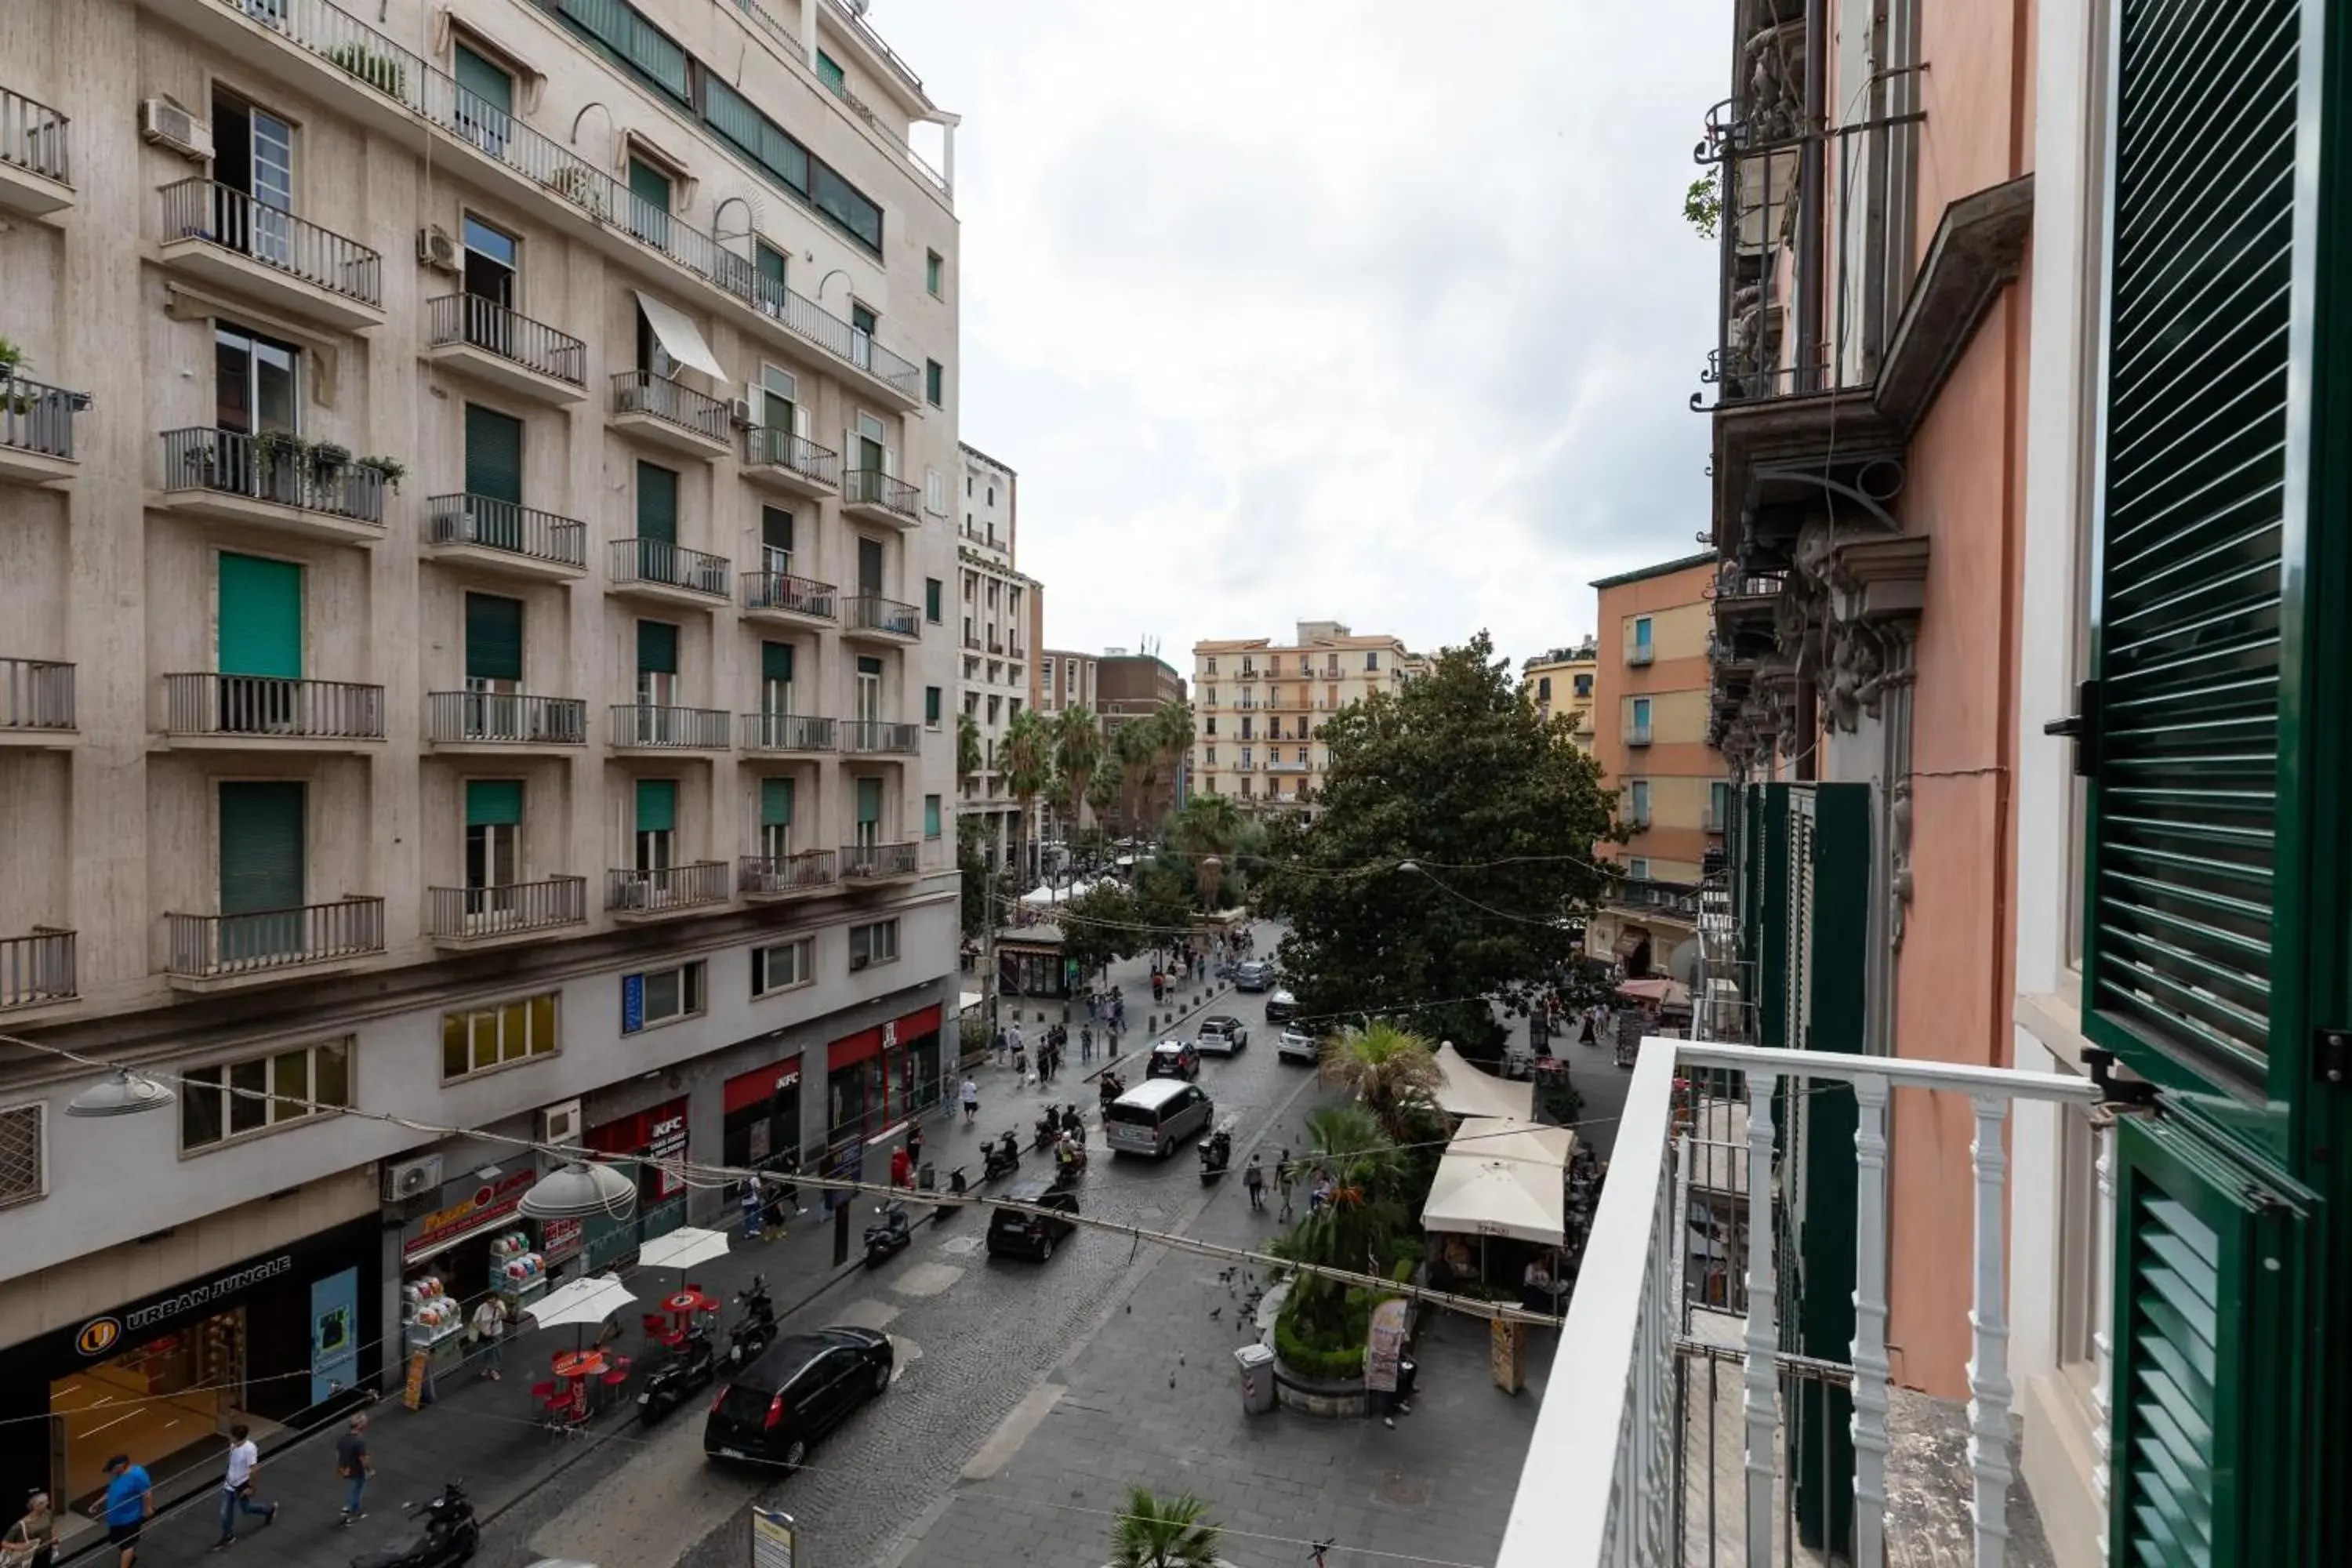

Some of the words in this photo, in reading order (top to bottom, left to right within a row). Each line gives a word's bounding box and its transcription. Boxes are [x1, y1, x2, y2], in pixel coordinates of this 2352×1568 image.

[775, 1072, 798, 1088] KFC
[652, 1116, 682, 1137] KFC
[127, 1287, 209, 1330] URBAN
[212, 1255, 292, 1298] JUNGLE
